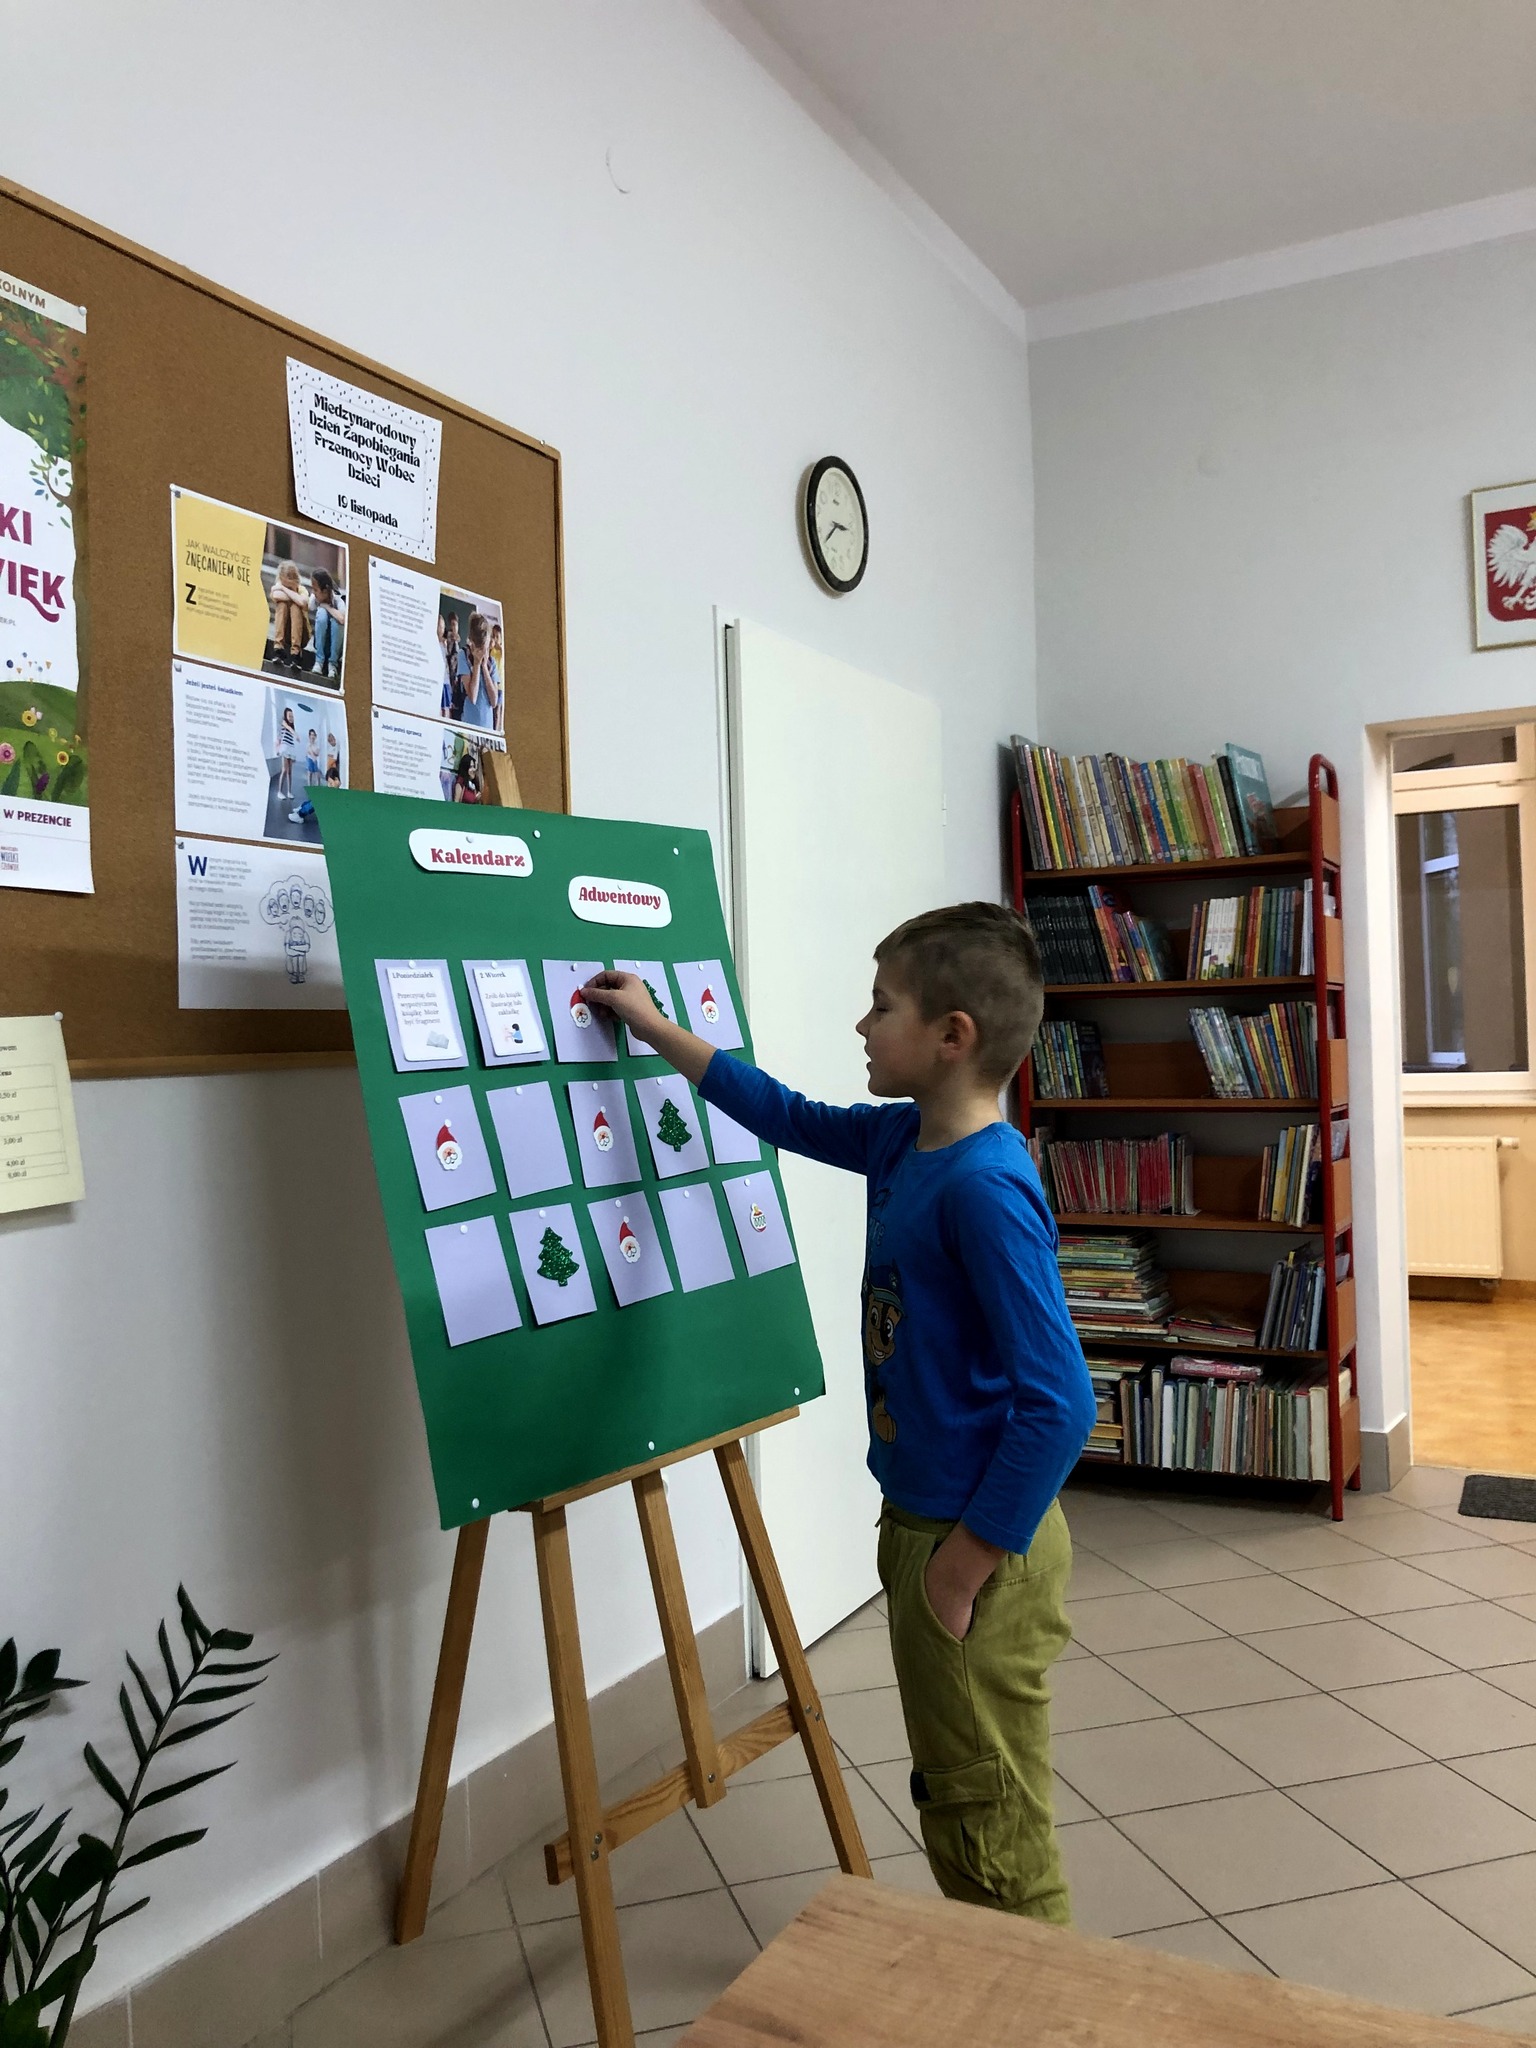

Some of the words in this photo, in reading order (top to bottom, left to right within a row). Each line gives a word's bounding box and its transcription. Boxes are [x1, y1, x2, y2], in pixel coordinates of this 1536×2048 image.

[309, 409, 341, 436] Dzień
[343, 424, 421, 468] Zapobiegania
[314, 430, 373, 470] Przemocy
[376, 455, 415, 484] Wobec
[348, 463, 381, 489] Dzieci
[337, 494, 348, 509] 19
[350, 498, 399, 528] listopada
[185, 539, 200, 549] JAK
[203, 543, 240, 563] WALCZYĆ
[241, 555, 251, 566] ZE
[185, 550, 234, 578] ZNĘCANIEM
[237, 566, 251, 586] SIĘ
[0, 557, 66, 623] IEK
[3, 809, 14, 819] W
[17, 810, 72, 827] PREZENCIE
[430, 848, 525, 867] Kalendarz
[578, 886, 661, 910] Adwentowy
